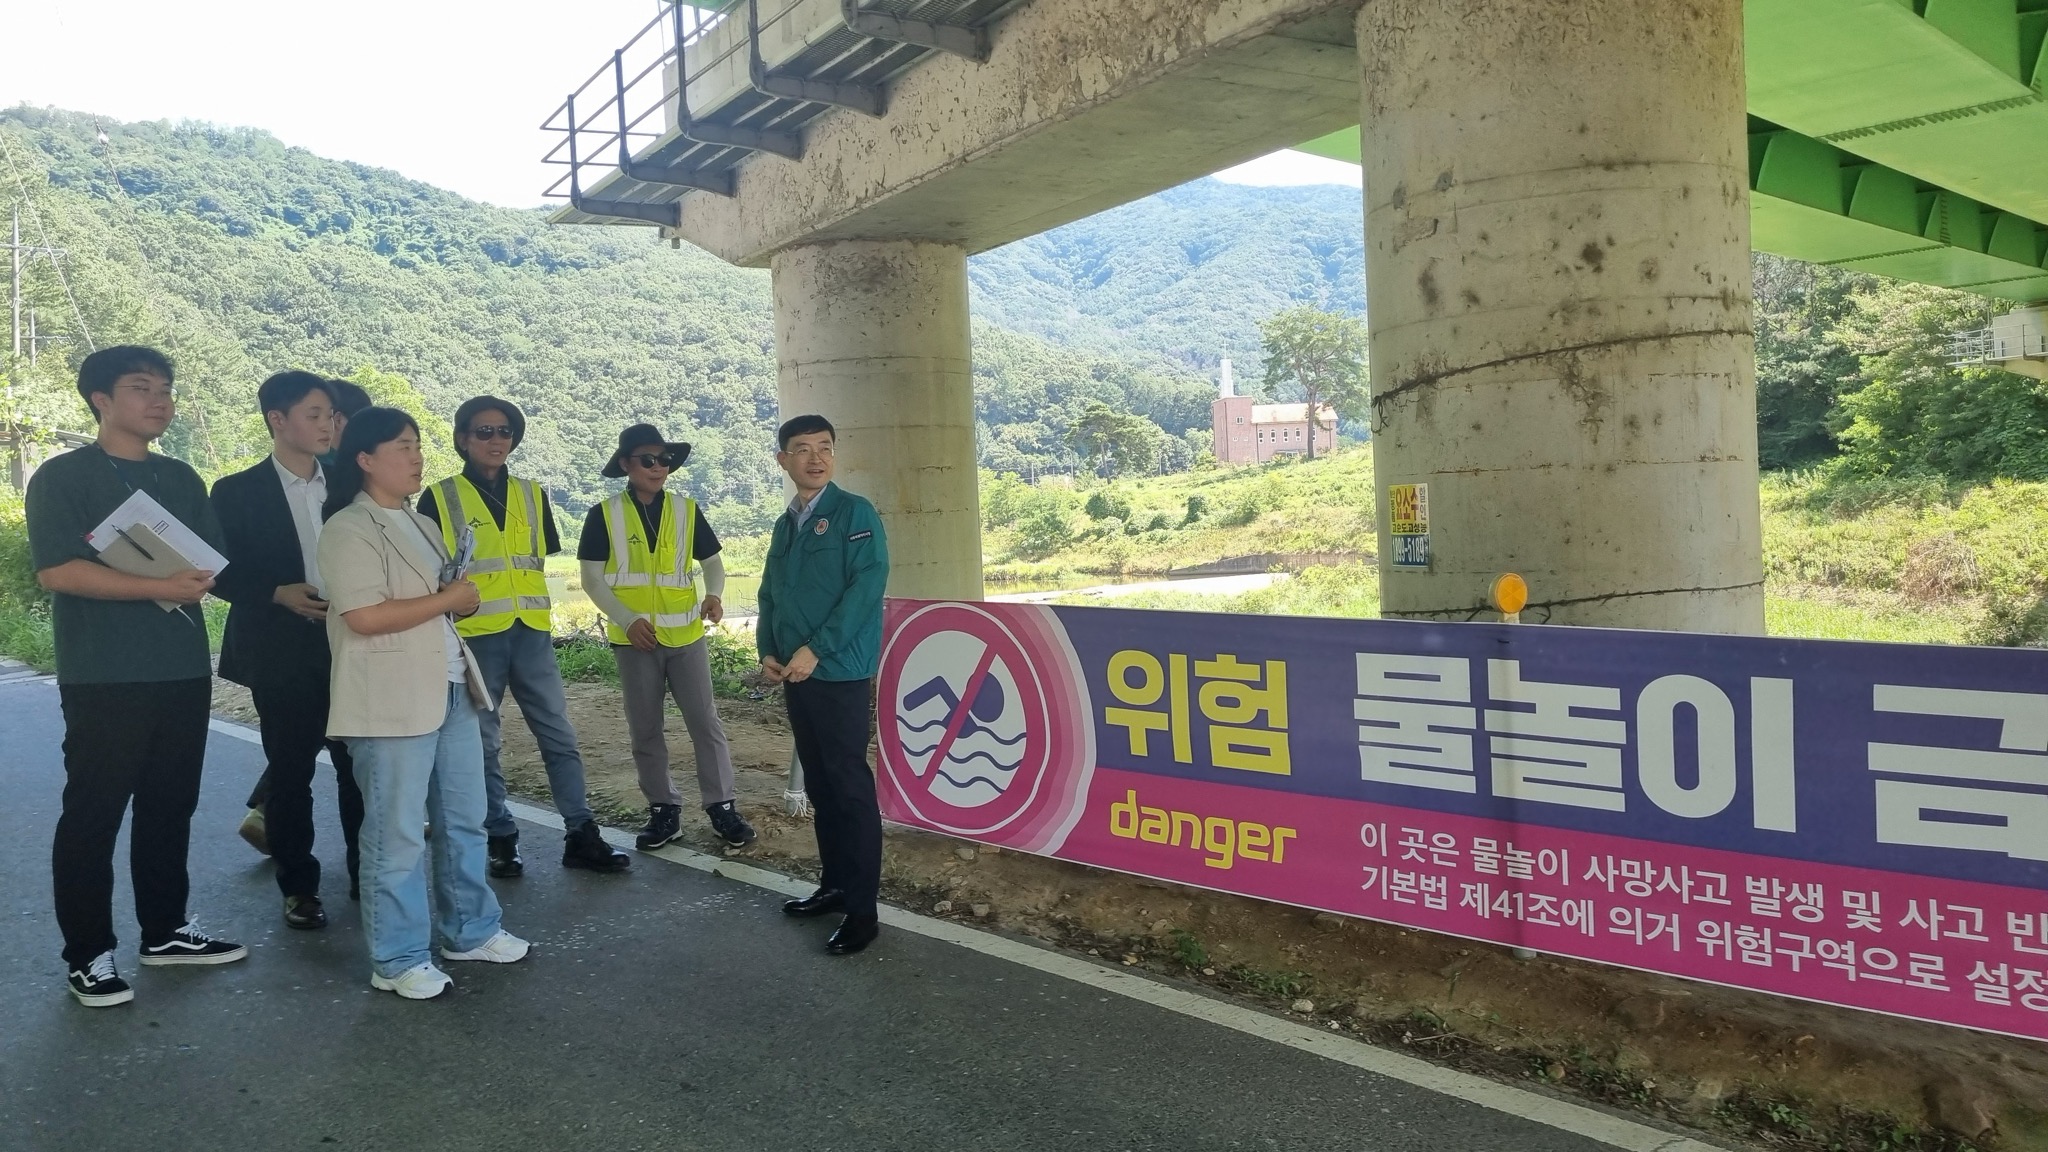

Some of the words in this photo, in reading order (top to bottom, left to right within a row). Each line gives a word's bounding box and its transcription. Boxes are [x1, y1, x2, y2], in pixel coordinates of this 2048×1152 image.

[1105, 649, 1291, 776] 위험
[1353, 652, 1797, 833] 물놀이
[1867, 683, 2048, 862] 금
[1110, 790, 1297, 870] danger
[1360, 822, 1388, 857] 이
[1398, 826, 1460, 868] 곳은
[1470, 836, 1569, 886] 물놀이
[1583, 854, 1732, 906] 사망사고
[1745, 875, 1825, 923] 발생
[1842, 890, 1883, 933] 및
[1898, 899, 1990, 942] 사고
[1361, 865, 1448, 911] 기본법
[1459, 882, 1595, 937] 제41조에
[1609, 905, 1681, 952] 의거
[1696, 920, 1951, 992] 위험구역으로
